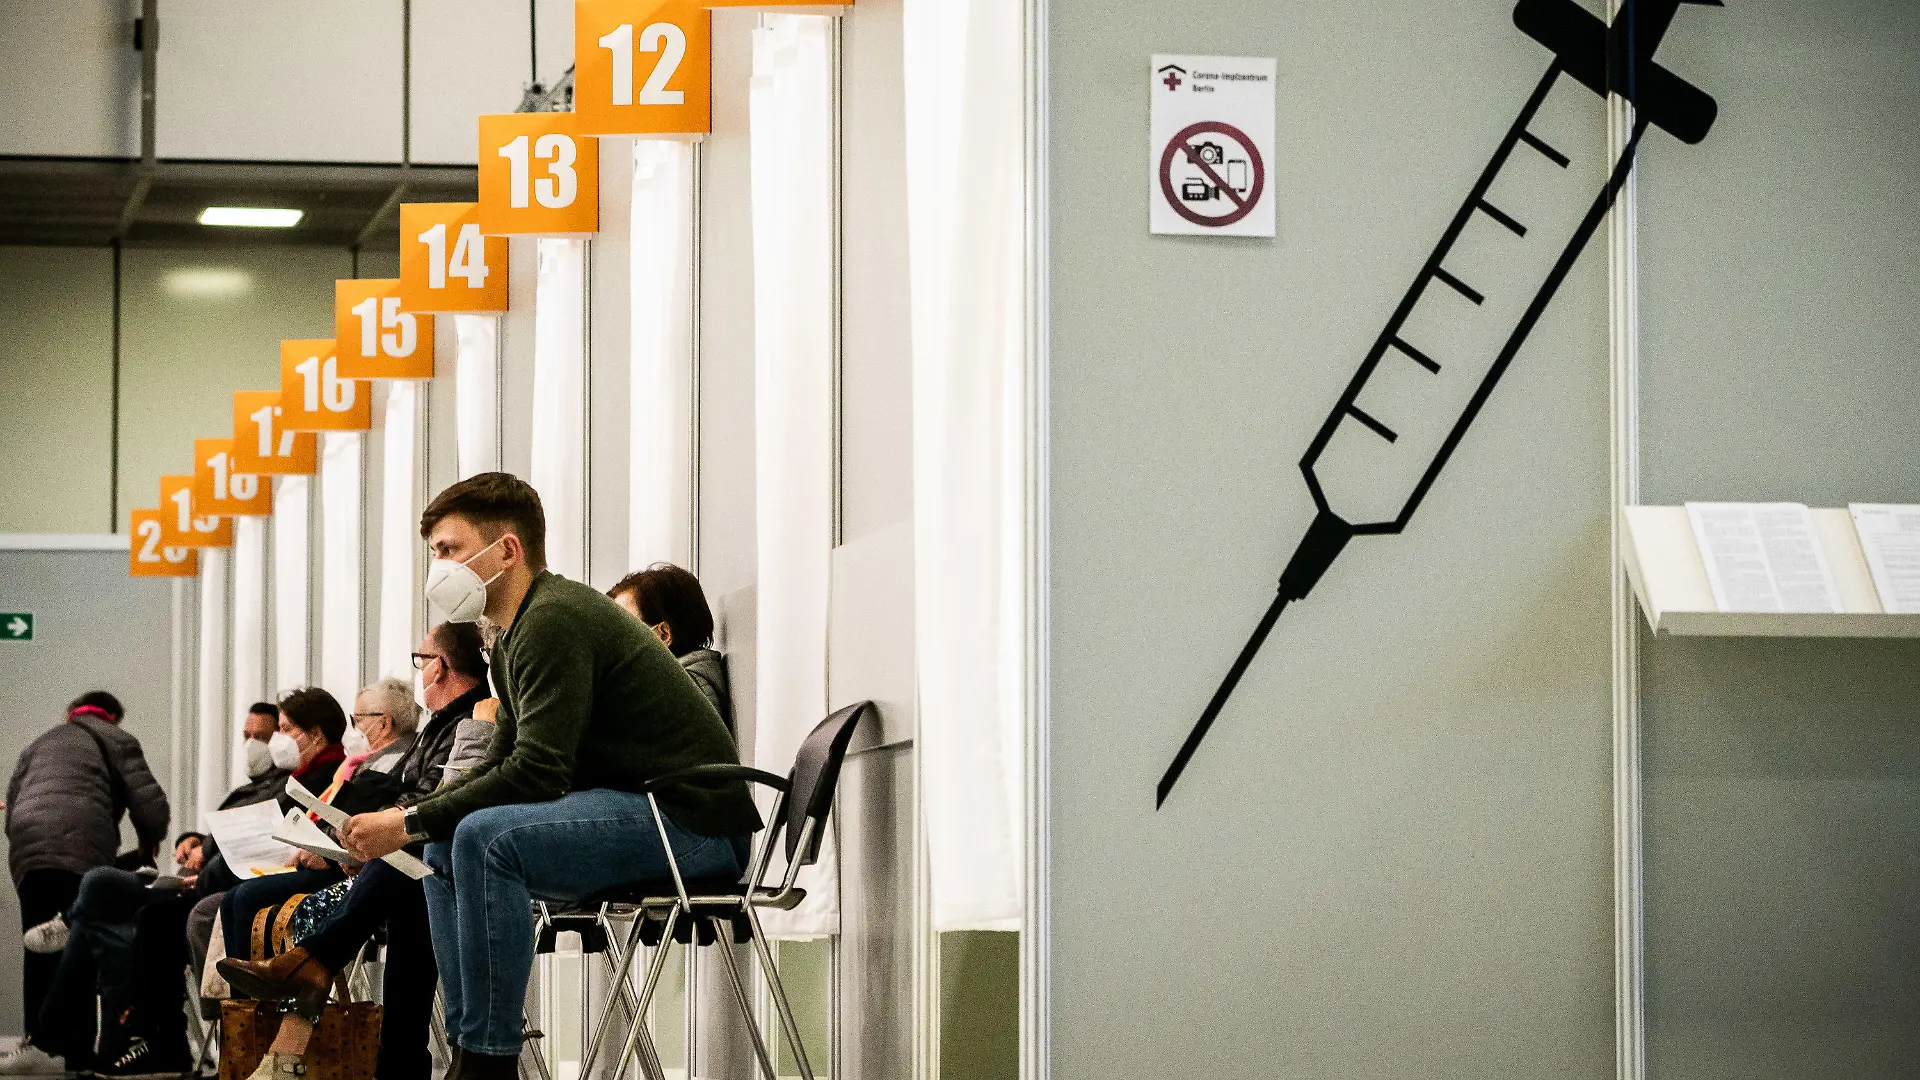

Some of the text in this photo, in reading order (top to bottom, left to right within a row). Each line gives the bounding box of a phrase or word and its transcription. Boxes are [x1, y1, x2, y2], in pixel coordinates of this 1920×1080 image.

[598, 22, 687, 106] 12
[1192, 84, 1214, 92] Berlin
[498, 133, 578, 209] 13
[417, 223, 489, 289] 14
[351, 296, 418, 359] 15
[295, 356, 356, 413] 16
